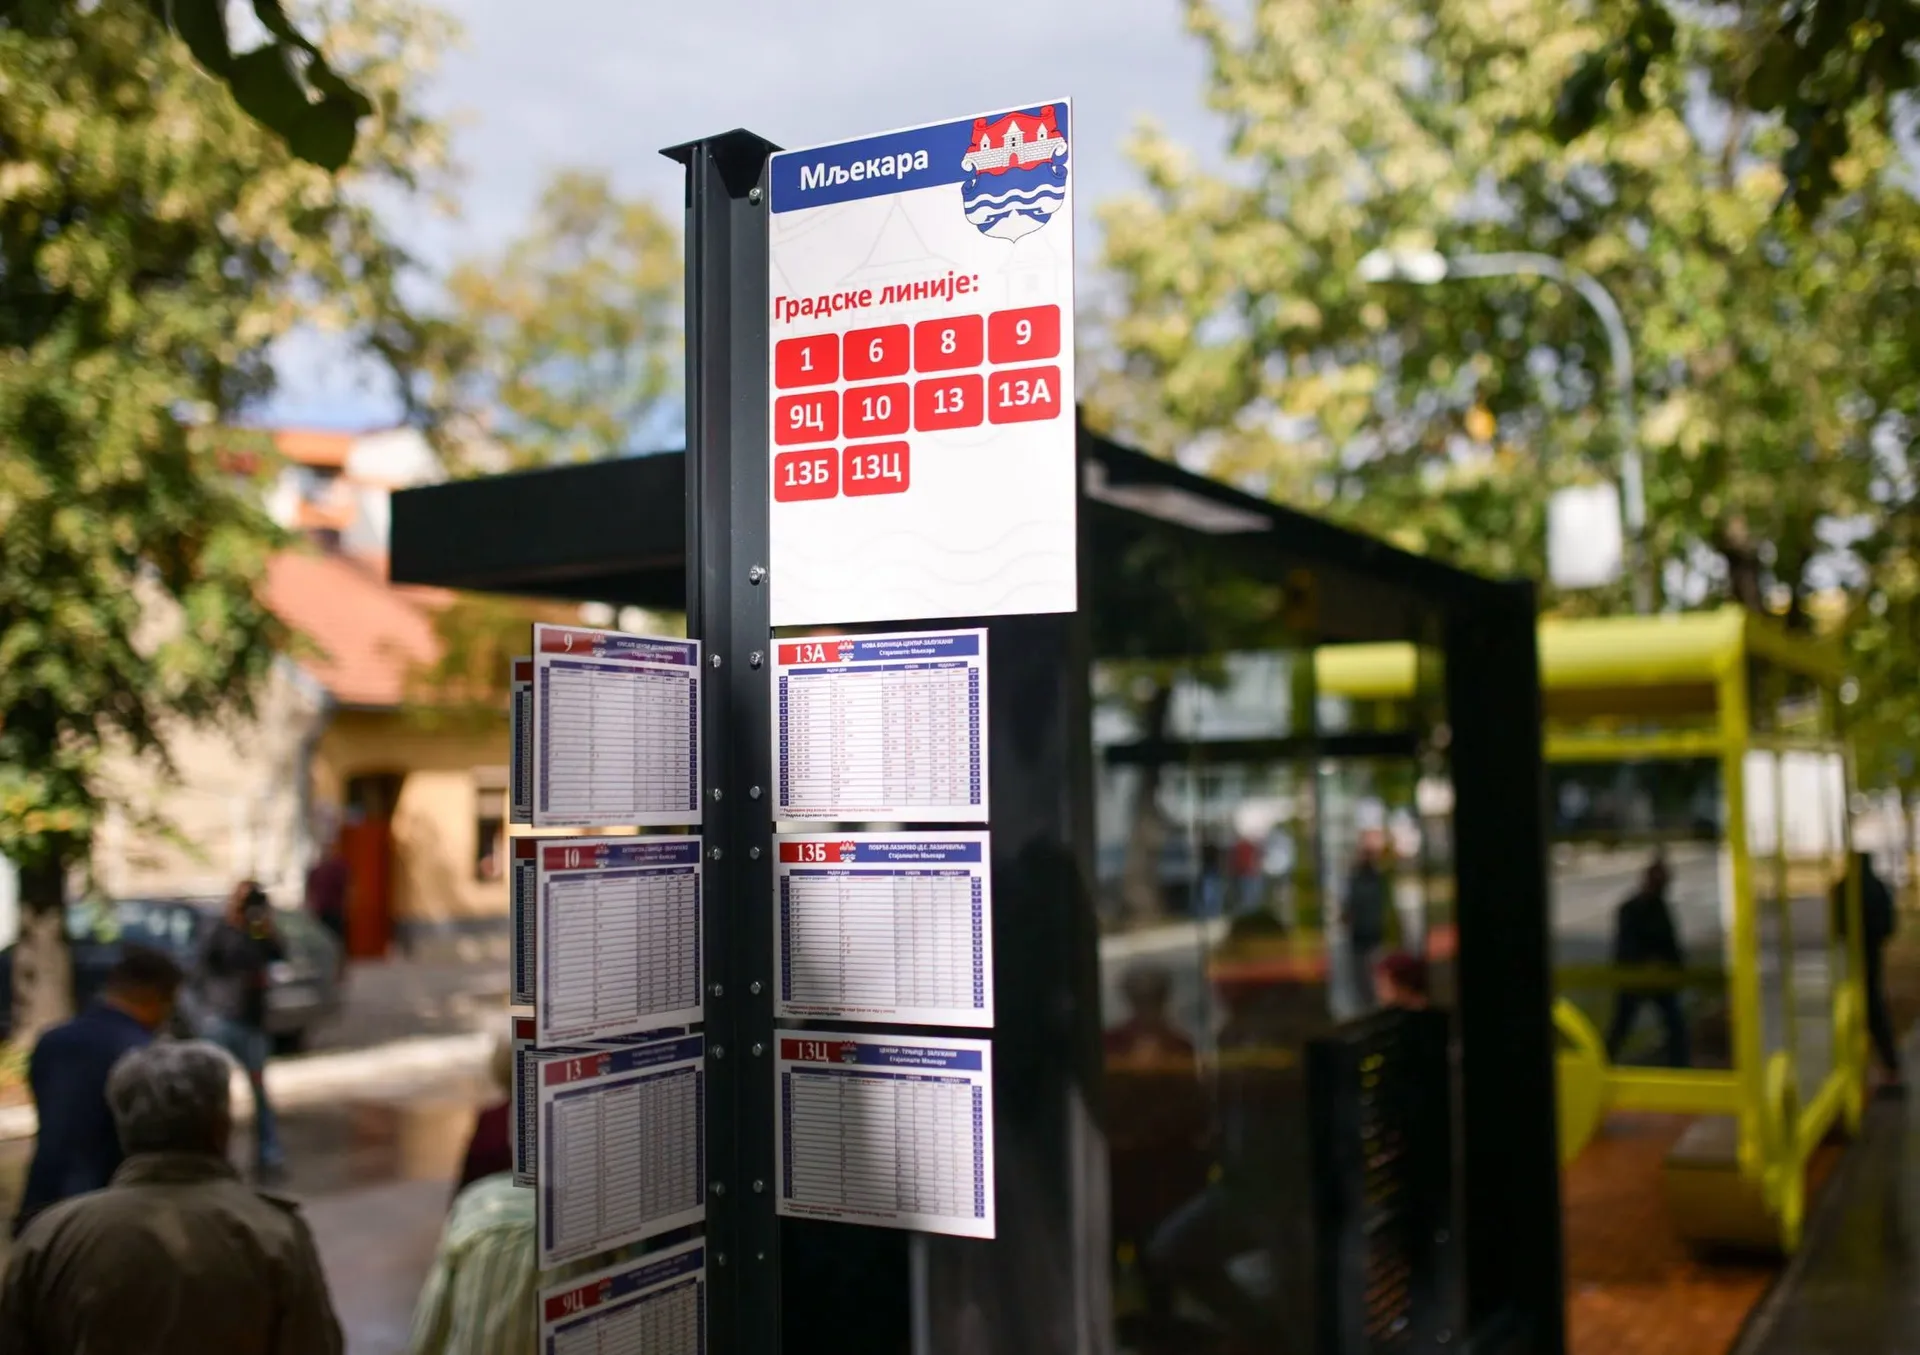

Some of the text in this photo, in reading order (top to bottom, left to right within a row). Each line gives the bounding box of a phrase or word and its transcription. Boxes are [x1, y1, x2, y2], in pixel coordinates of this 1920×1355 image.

[800, 149, 928, 191] Мљекара
[774, 270, 980, 323] Градске линије:
[800, 319, 1032, 372] 1 6 8 9
[789, 378, 1052, 432] 9Ц 10 13 13А
[784, 453, 902, 487] 13Б 13Ц
[564, 633, 573, 652] 9
[795, 643, 826, 663] 13А
[564, 848, 580, 869] 10
[797, 843, 826, 862] 13Б
[798, 1042, 829, 1064] 13Ц
[566, 1060, 582, 1081] 13
